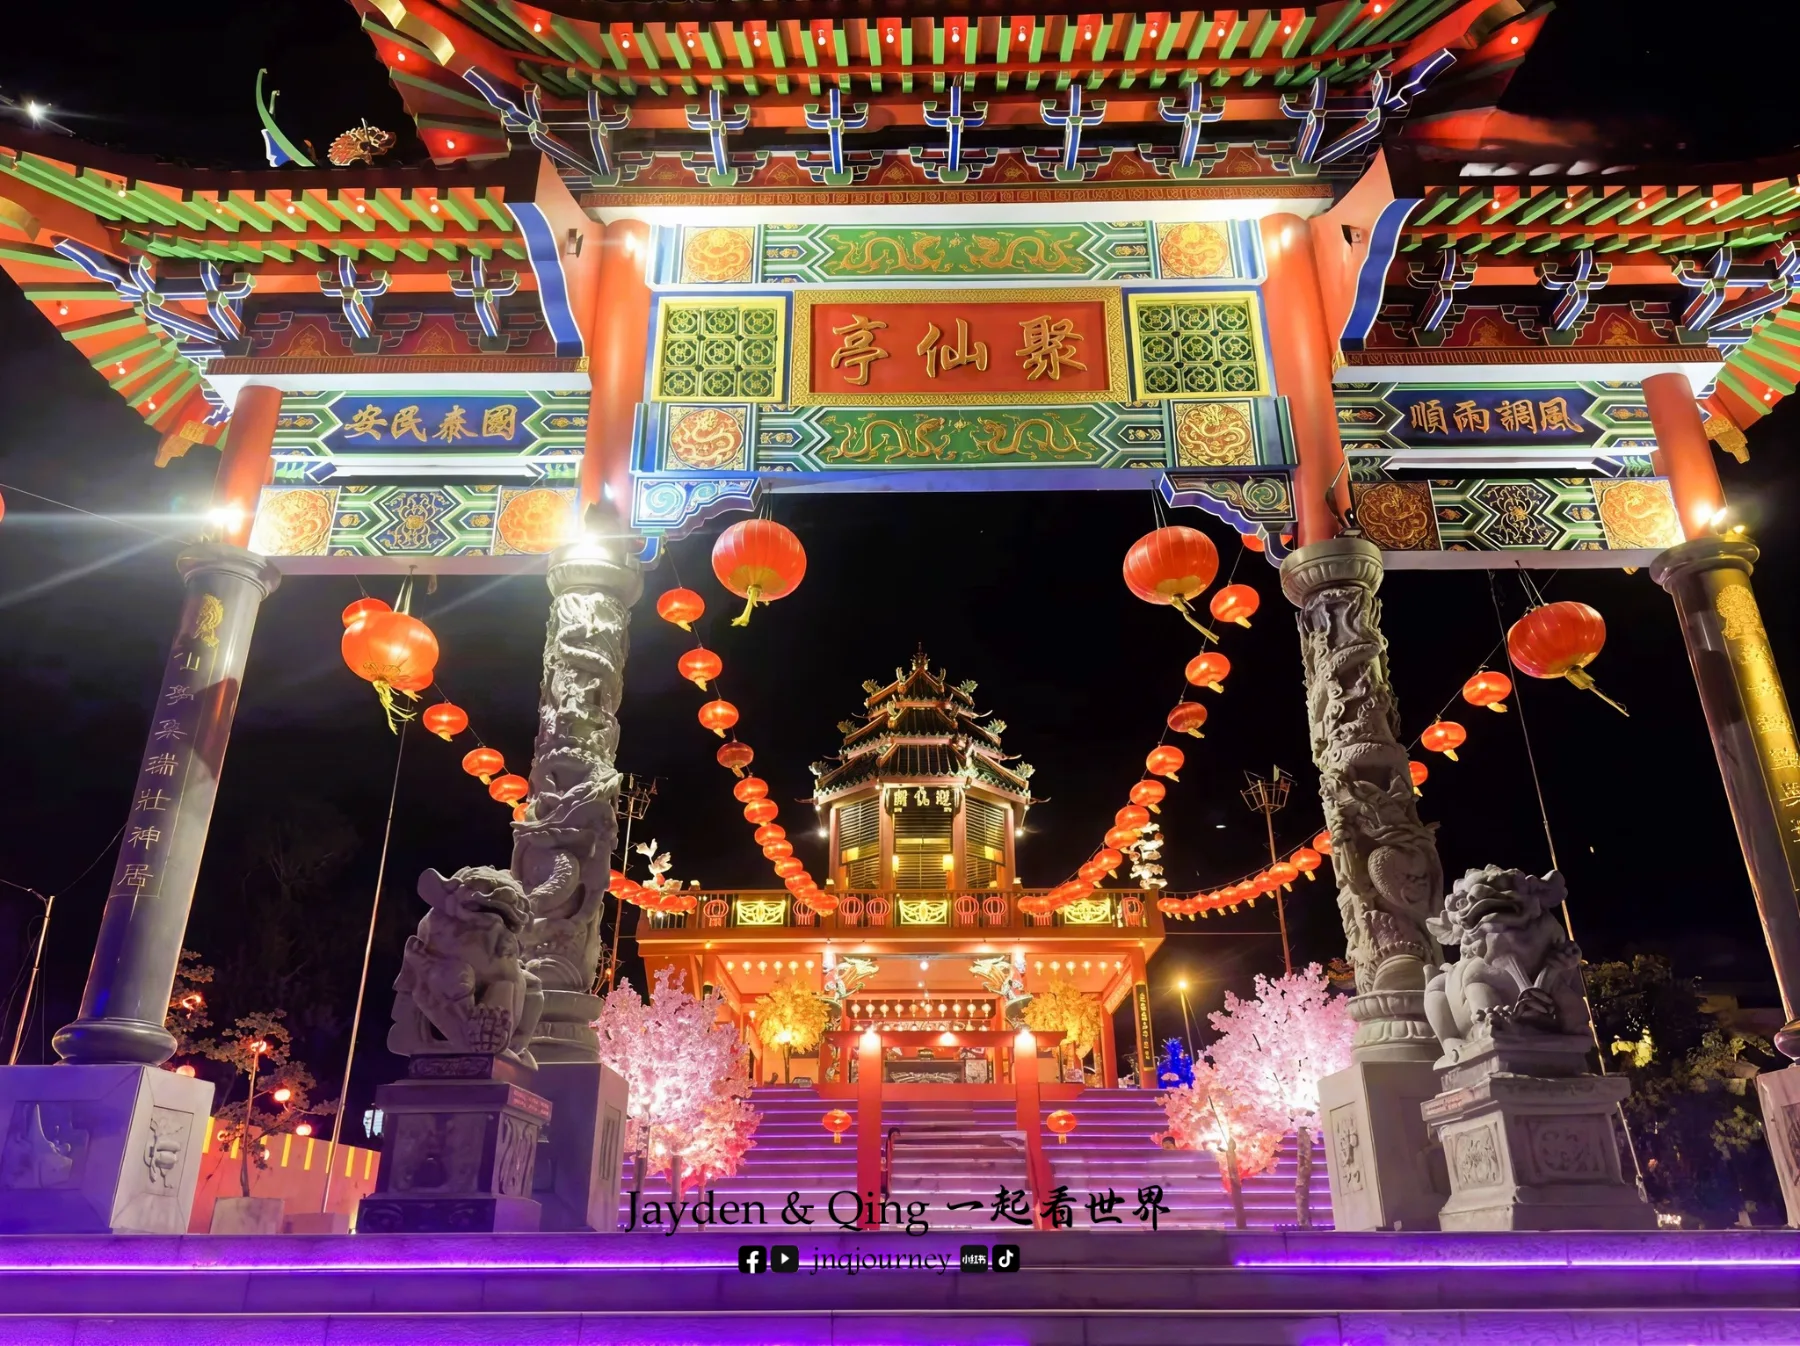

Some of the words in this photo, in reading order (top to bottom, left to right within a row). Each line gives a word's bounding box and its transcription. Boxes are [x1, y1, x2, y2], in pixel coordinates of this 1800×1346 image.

[830, 313, 1088, 386] 聚仙亭
[344, 404, 518, 443] 國泰民安
[1410, 396, 1585, 436] 風調雨順
